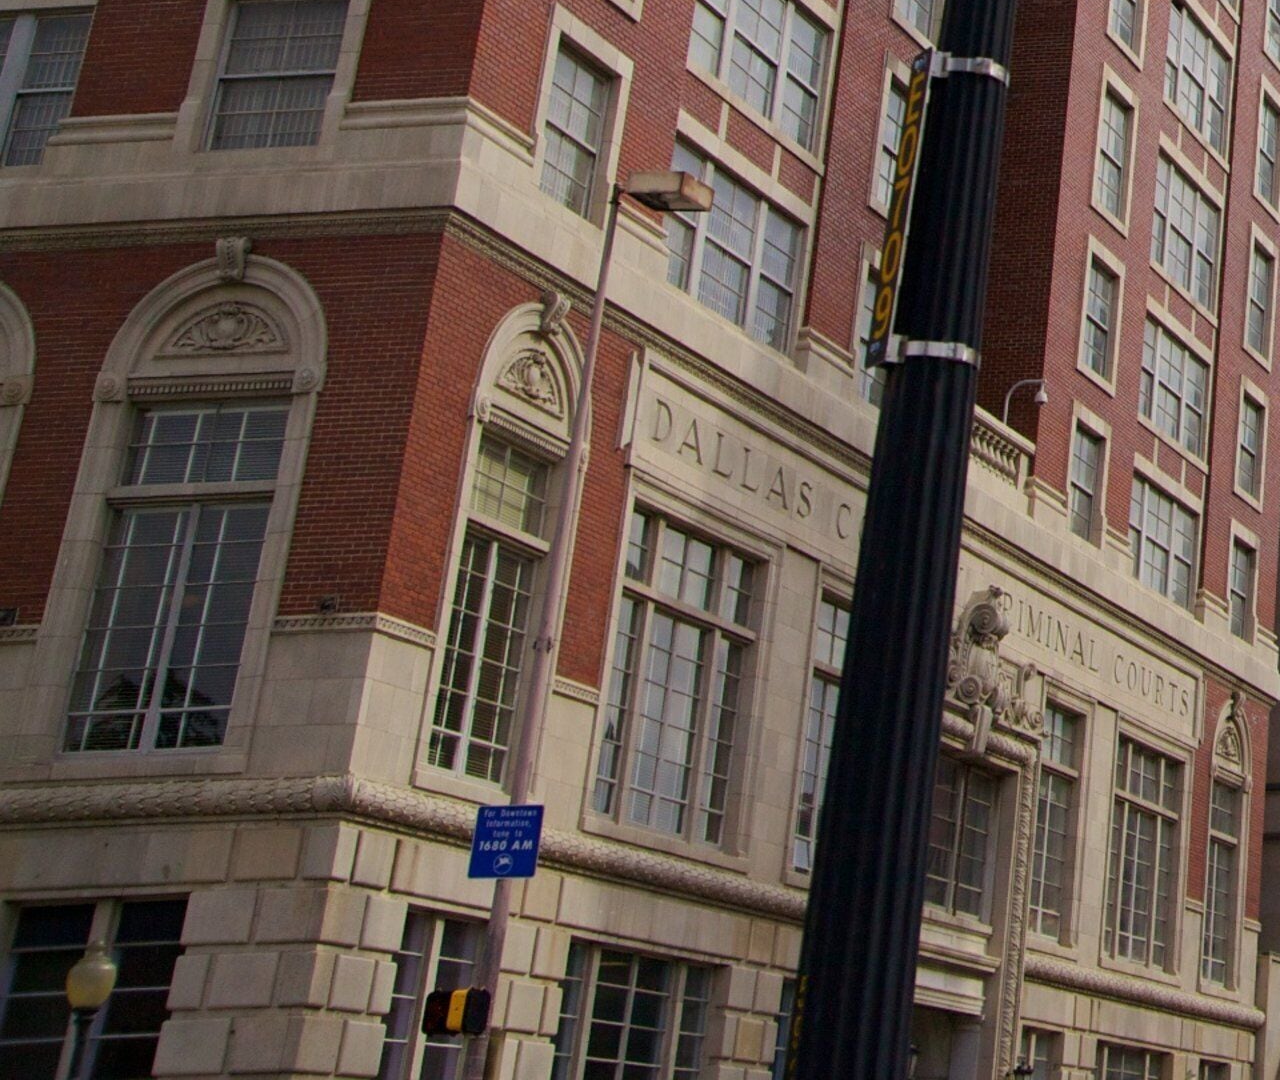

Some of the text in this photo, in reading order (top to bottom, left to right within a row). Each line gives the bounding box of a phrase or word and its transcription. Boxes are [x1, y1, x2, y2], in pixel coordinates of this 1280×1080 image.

[652, 398, 813, 518] DALLAS
[1002, 591, 1189, 717] RIMINAL COURTS
[479, 839, 533, 851] 1680 AM
[484, 808, 538, 817] For Downtown
